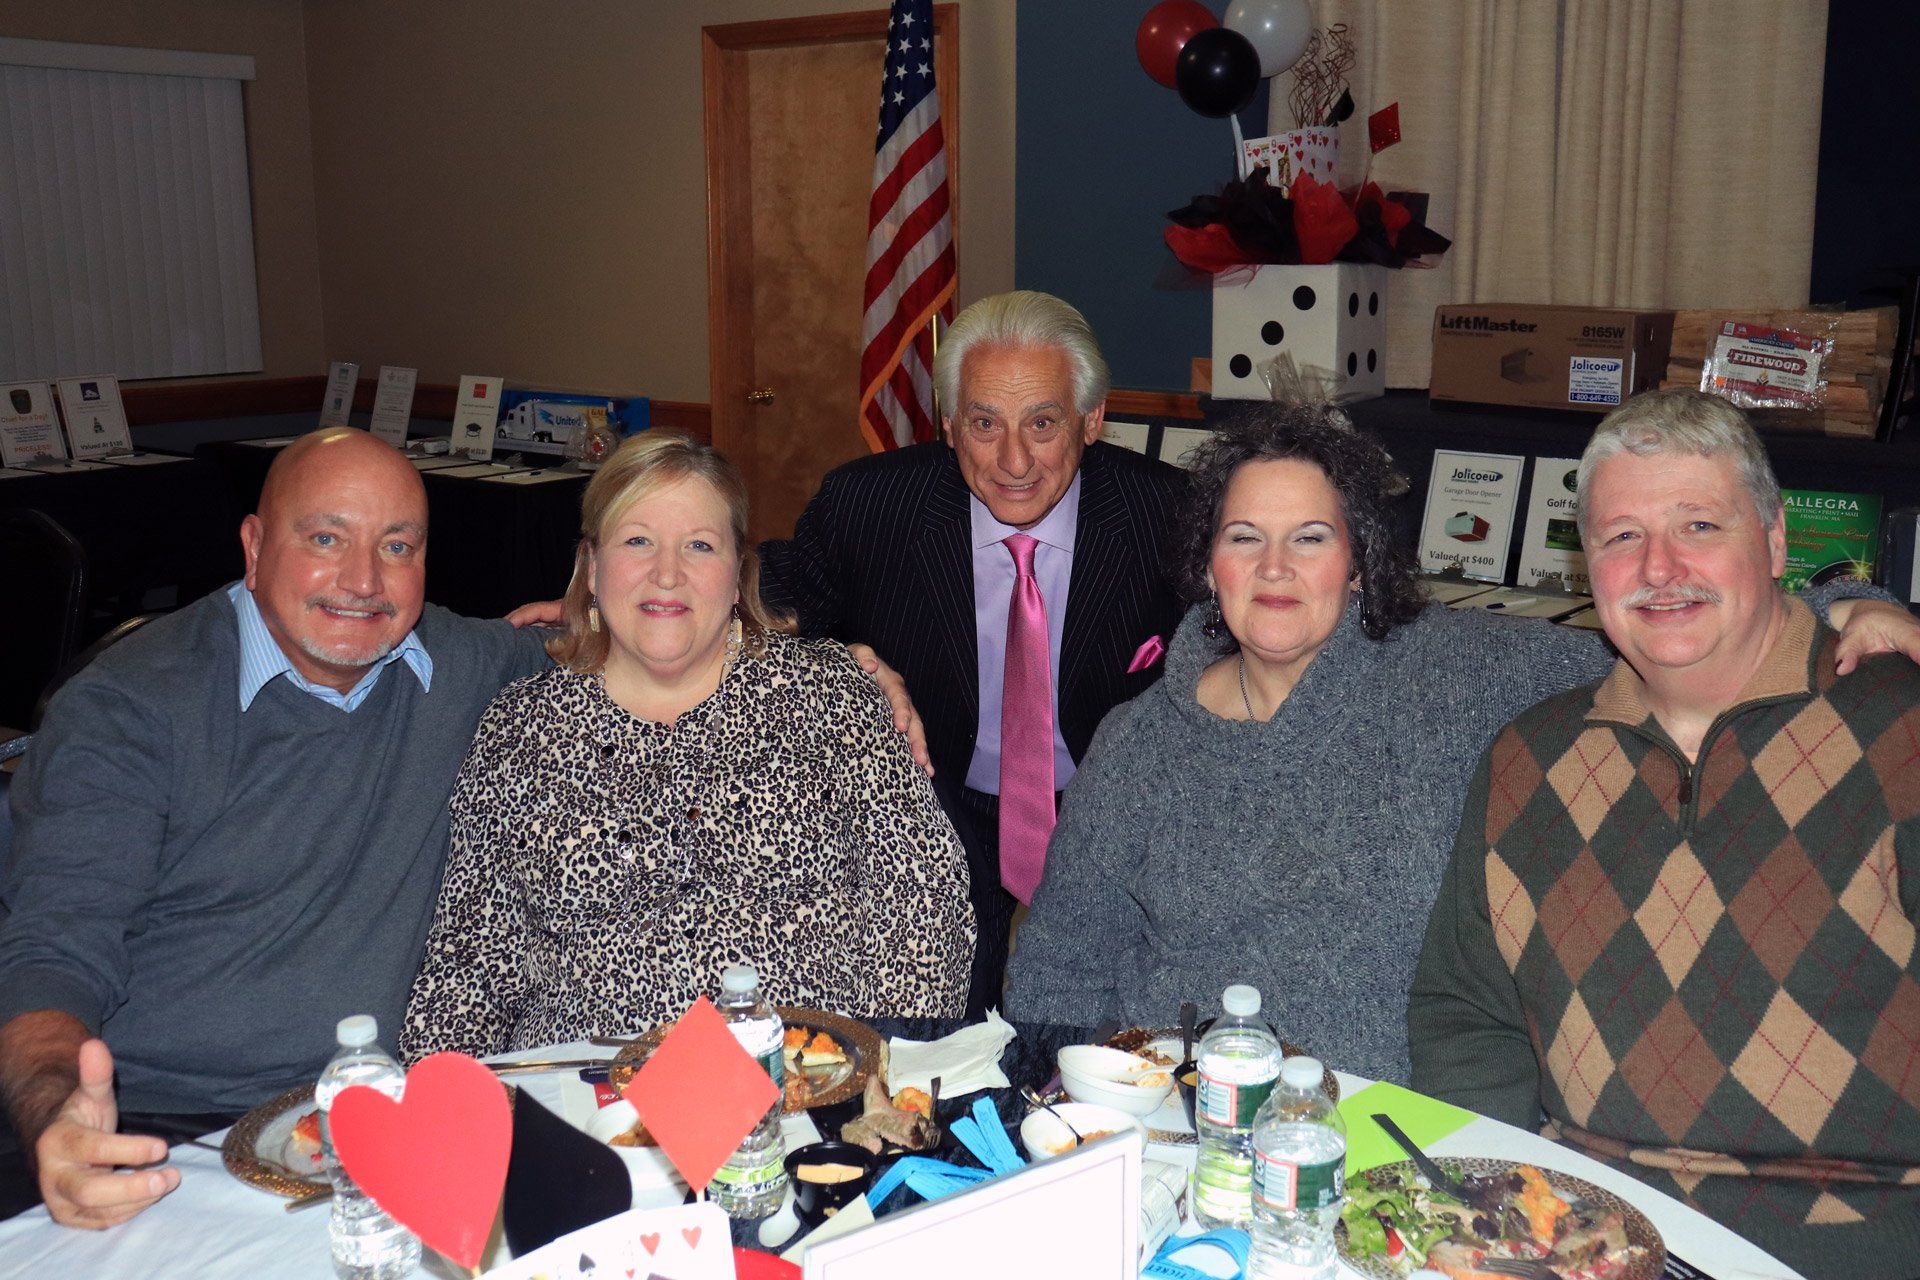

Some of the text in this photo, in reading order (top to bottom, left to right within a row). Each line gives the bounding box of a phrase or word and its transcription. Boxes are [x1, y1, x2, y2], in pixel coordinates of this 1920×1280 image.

[1440, 314, 1537, 333] LiftMaster
[1582, 325, 1626, 338] 8165W
[1572, 359, 1620, 371] Jolicoeur
[1733, 352, 1802, 371] FIREWOOD
[555, 415, 582, 428] United
[1451, 468, 1502, 481] Jolicoeur
[1444, 486, 1502, 499] Garage Door Opener
[1546, 498, 1567, 508] Golf
[1784, 496, 1859, 511] ALLEGRA
[1429, 550, 1495, 566] Valued at $400
[1575, 573, 1590, 584] $2
